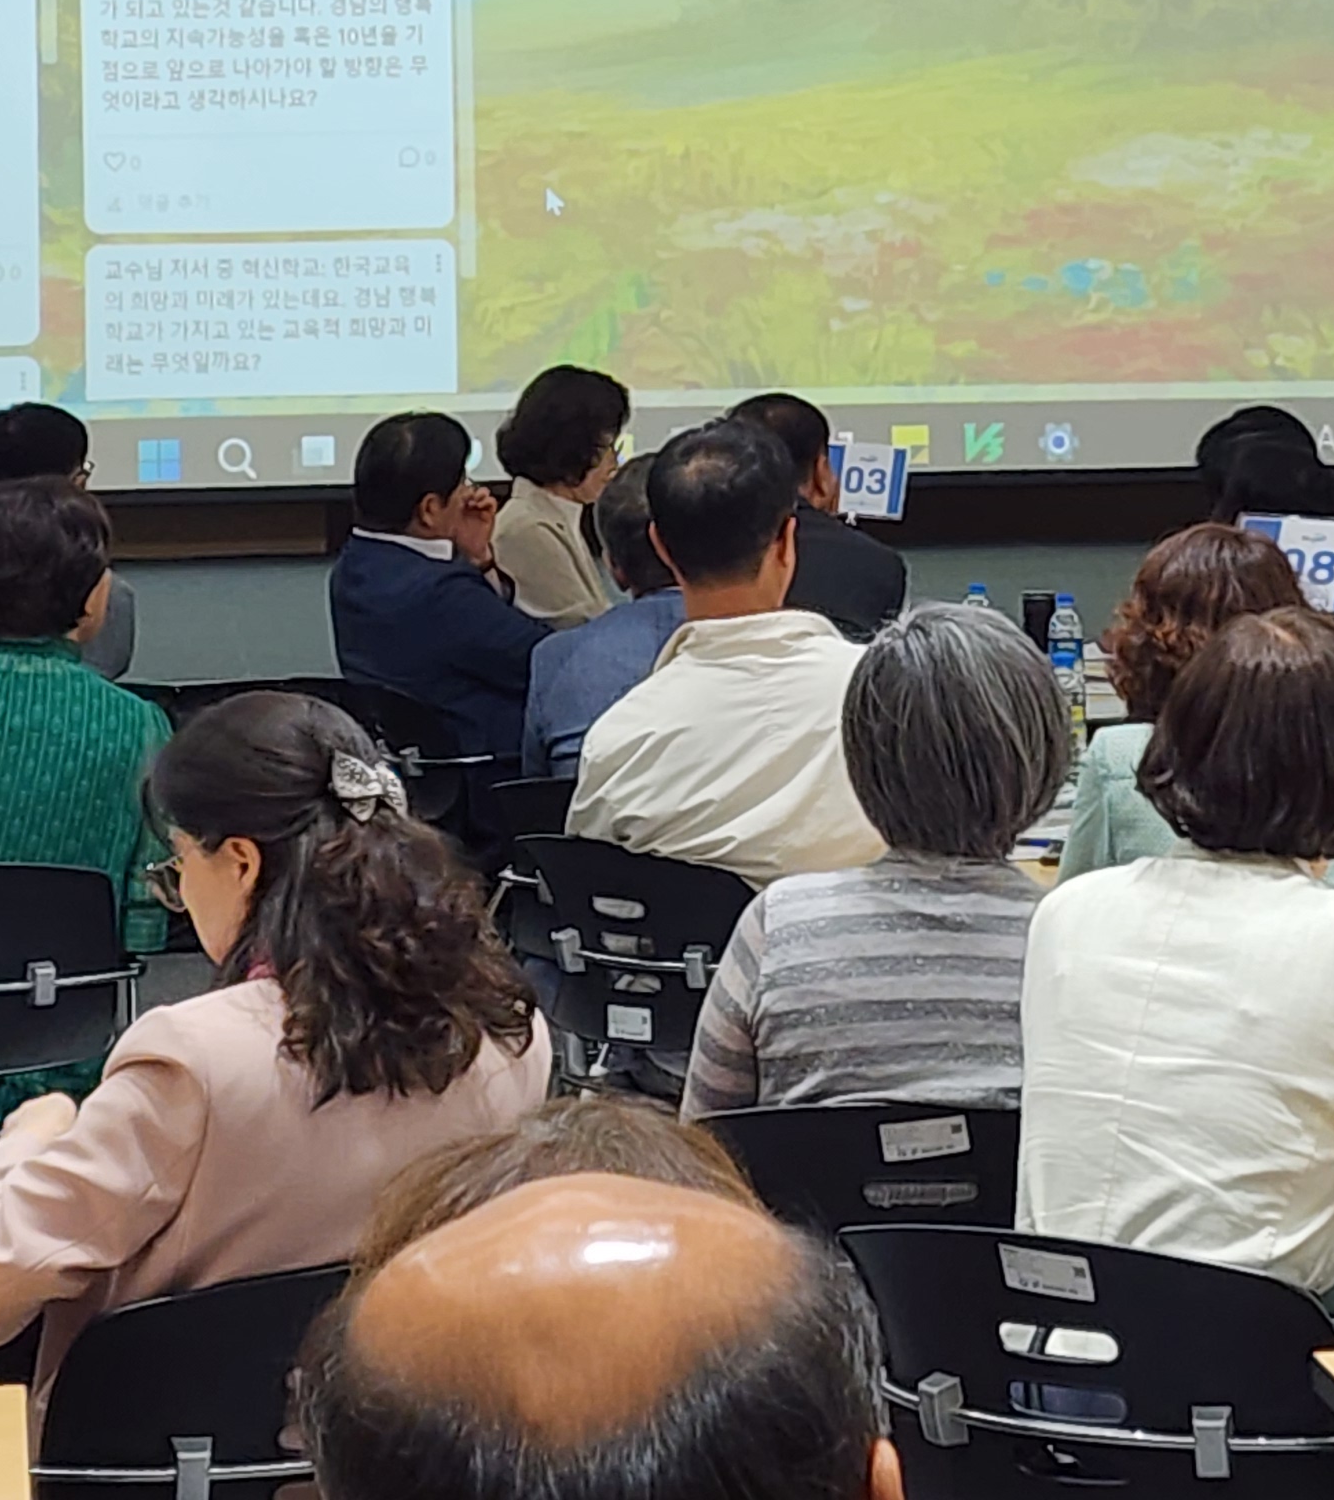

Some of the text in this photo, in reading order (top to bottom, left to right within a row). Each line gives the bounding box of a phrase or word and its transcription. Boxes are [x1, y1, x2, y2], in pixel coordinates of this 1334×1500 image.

[99, 0, 118, 20] 가
[125, 0, 164, 19] 되고
[100, 29, 159, 50] 학교의
[167, 27, 285, 49] 지속가능성을
[338, 25, 397, 47] 10년을
[405, 24, 423, 45] 기
[101, 60, 159, 82] 점으로
[167, 59, 226, 81] 앞으로
[344, 55, 403, 78] 방향은
[410, 56, 428, 77] 무
[101, 88, 318, 113] 엇이라고 생각하시나요?
[105, 259, 163, 280] 교수님
[169, 258, 208, 279] 저서
[333, 255, 410, 277] 한국교육
[105, 291, 123, 312] 의
[195, 289, 254, 310] 미래가
[354, 287, 391, 309] 경남
[398, 285, 436, 308] 행복
[105, 320, 163, 342] 학교가
[170, 319, 230, 341] 가지고
[237, 318, 275, 340] 있는
[283, 317, 341, 338] 교육적
[414, 315, 432, 337] 미
[105, 351, 262, 375] 래는 무엇일까요?
[844, 466, 887, 495] 03
